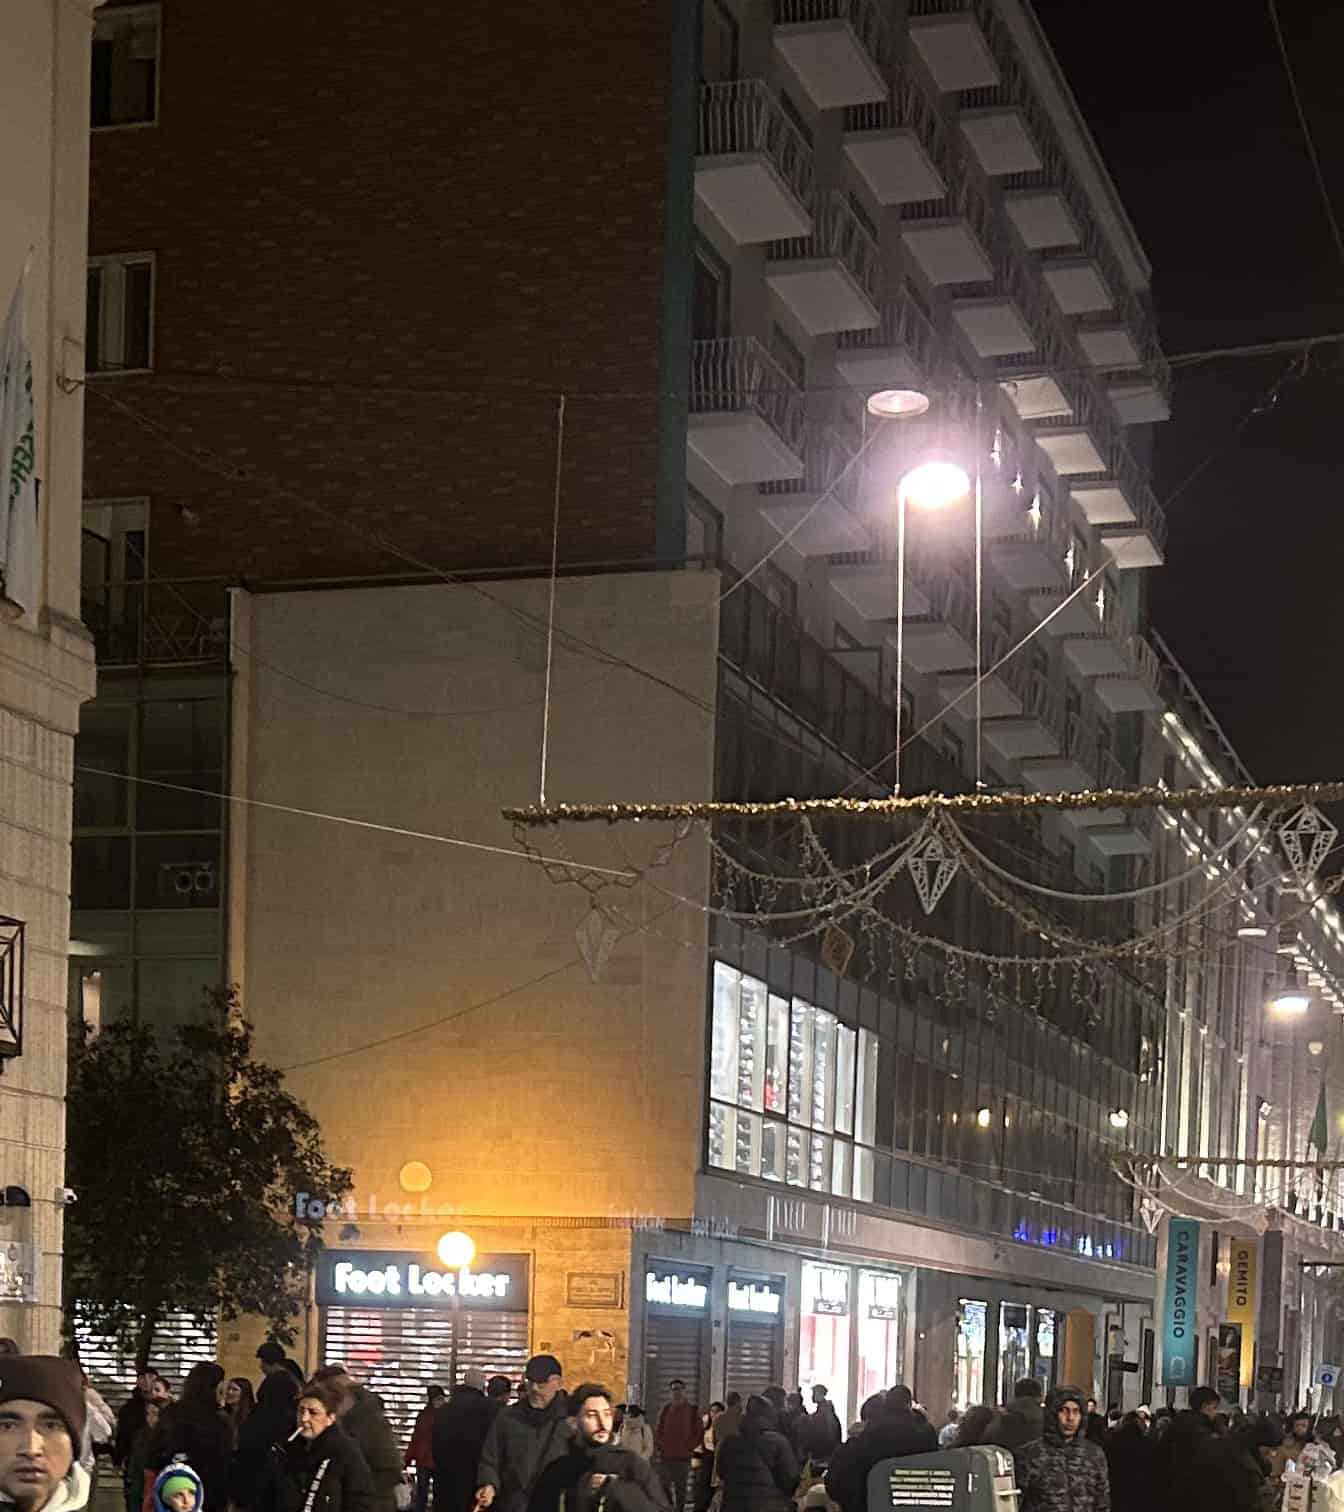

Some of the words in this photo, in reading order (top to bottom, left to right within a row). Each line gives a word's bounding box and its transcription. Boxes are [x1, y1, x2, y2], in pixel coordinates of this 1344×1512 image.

[335, 1262, 401, 1295] Foot
[408, 1265, 511, 1298] Locker
[1172, 1230, 1190, 1339] CARAVAGGIO
[1235, 1250, 1249, 1307] GEMITO
